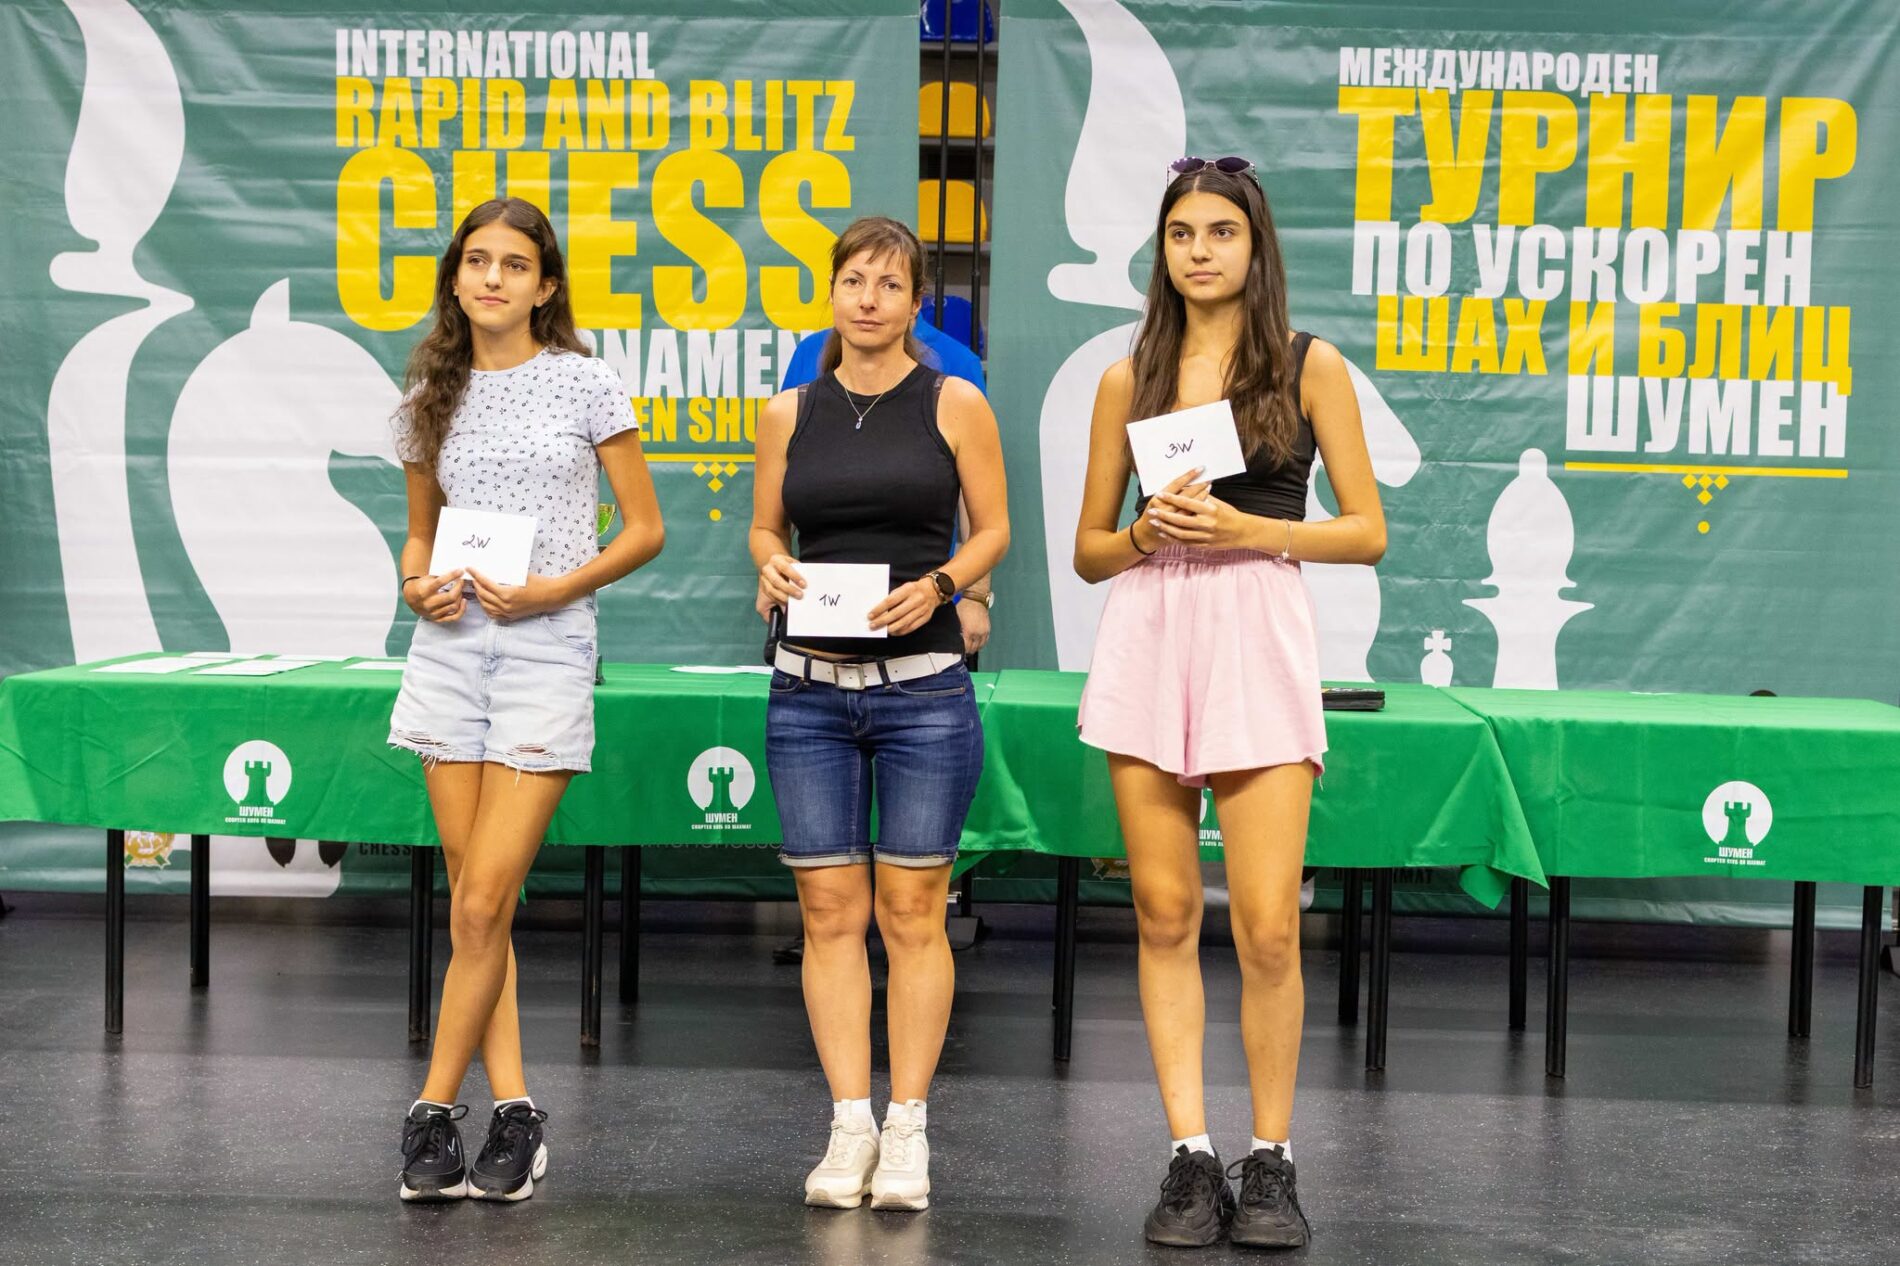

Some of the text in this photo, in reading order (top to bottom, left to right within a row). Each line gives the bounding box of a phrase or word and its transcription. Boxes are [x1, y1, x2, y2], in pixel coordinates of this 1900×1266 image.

[336, 29, 655, 78] INTERNATIONAL
[1339, 47, 1659, 98] МЕЖДУНАРОДЕН
[336, 76, 855, 152] RAPID AND BLITZ
[1338, 86, 1857, 232] ТУРНИР
[1351, 221, 1812, 307] ПО УСКОРЕН
[1376, 295, 1852, 396] ШАХ И БЛИЦ
[631, 396, 677, 442] EN
[1566, 375, 1848, 458] ШУМЕН
[1164, 439, 1194, 459] 3W
[819, 593, 841, 606] 1W
[239, 806, 273, 818] ШУМЕН
[705, 812, 738, 823] ШУМЕН
[1198, 829, 1223, 841] ШУМ
[1719, 847, 1753, 859] ШУМЕН
